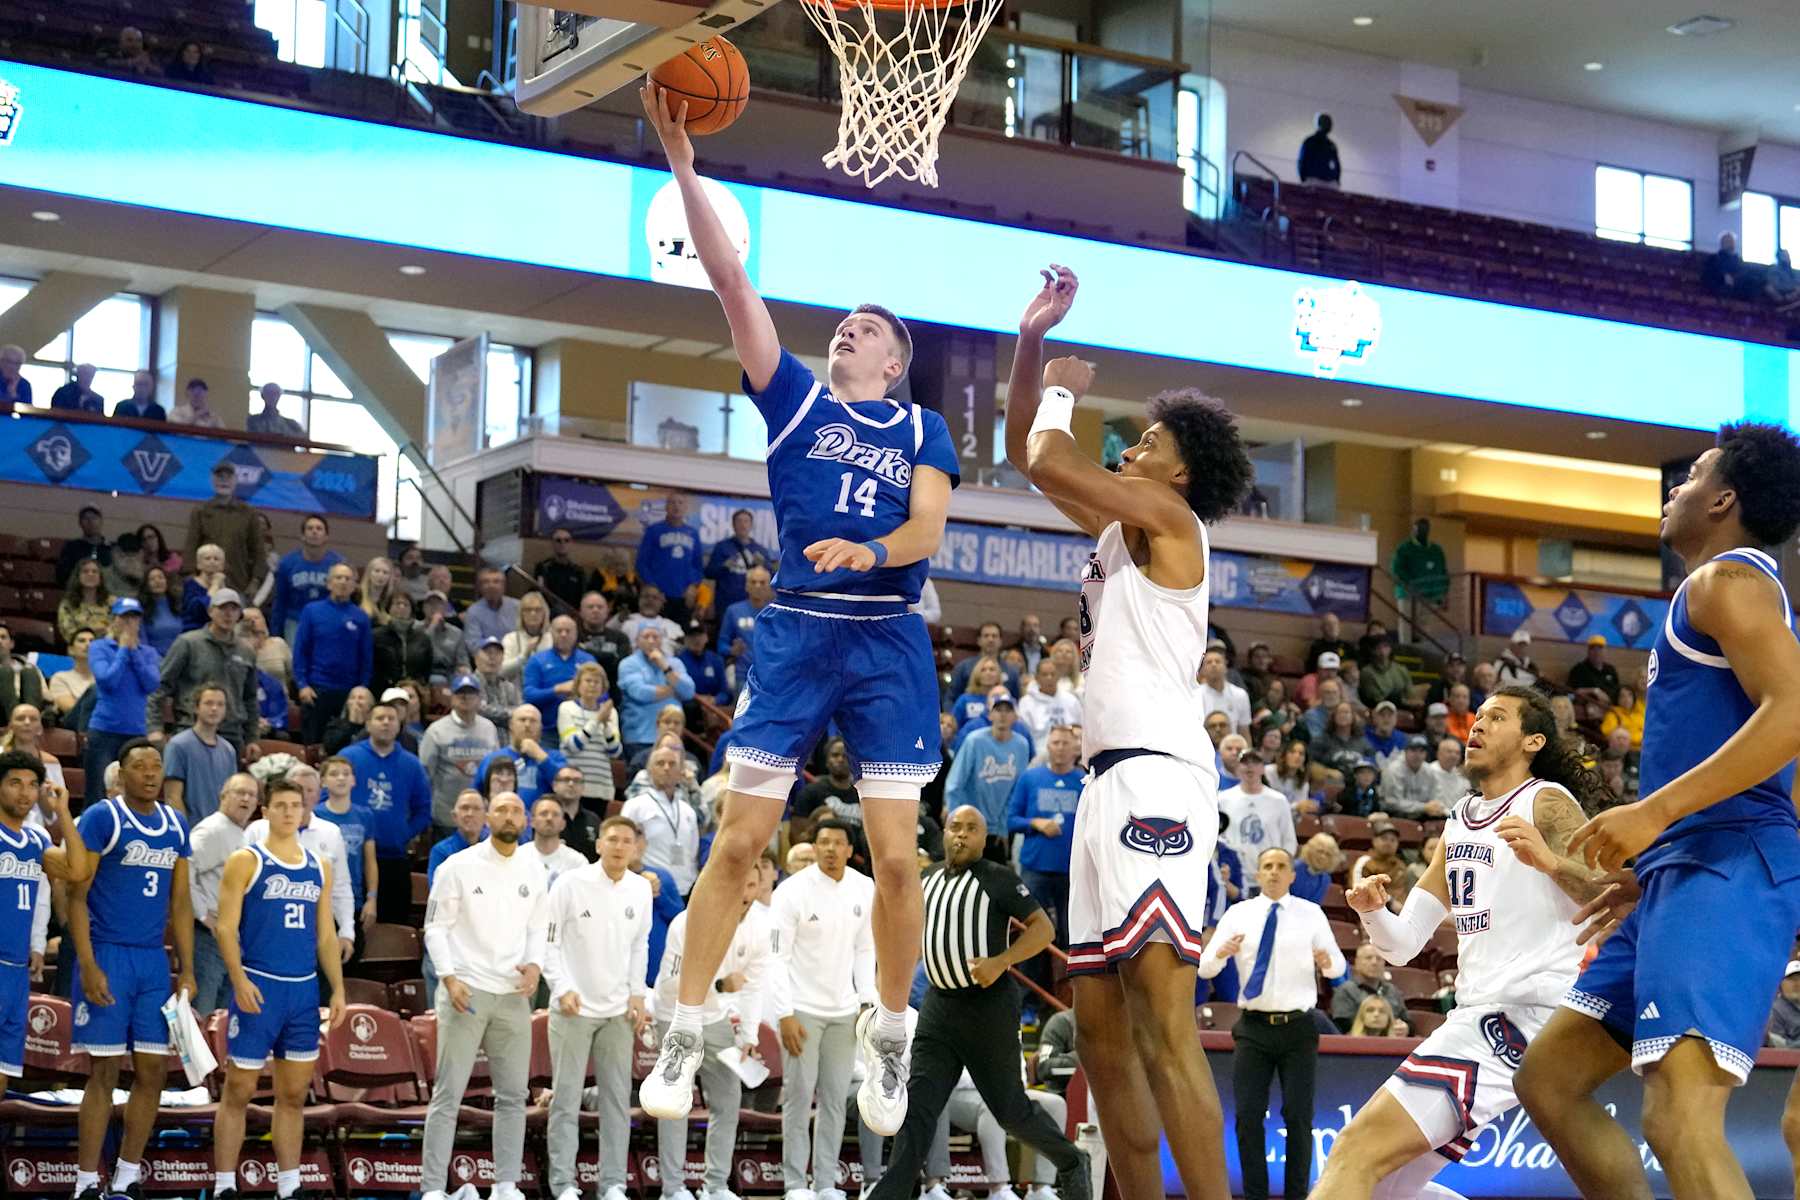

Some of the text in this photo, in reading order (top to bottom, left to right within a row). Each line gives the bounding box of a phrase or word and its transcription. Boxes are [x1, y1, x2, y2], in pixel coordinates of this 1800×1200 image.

[807, 423, 912, 489] Drake
[834, 472, 878, 518] 14
[983, 535, 1091, 584] CHARLES
[1446, 843, 1494, 867] LORIDA
[17, 883, 31, 910] 11
[143, 871, 158, 896] 3
[263, 874, 321, 902] Drake
[1448, 868, 1476, 908] 12
[284, 903, 305, 929] 21
[37, 1161, 80, 1172] Shrine
[38, 1173, 79, 1183] Childr
[153, 1160, 208, 1170] Shriners
[154, 1171, 216, 1182] Children's
